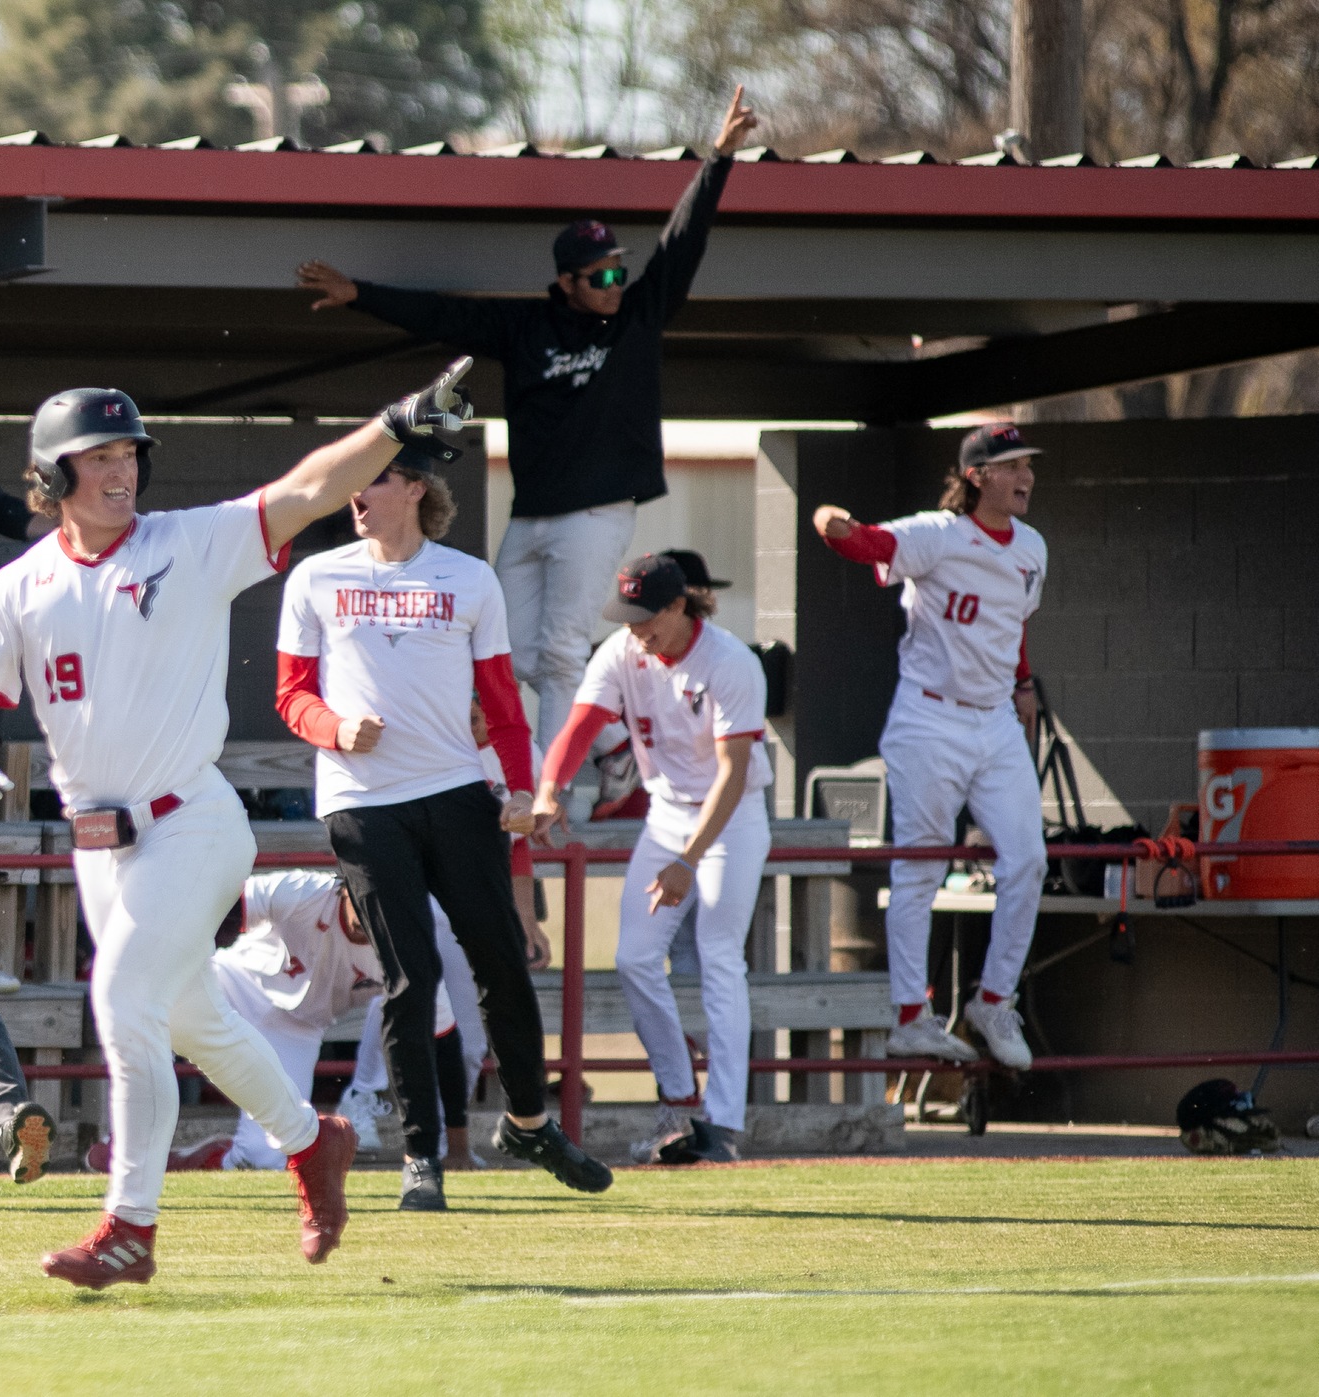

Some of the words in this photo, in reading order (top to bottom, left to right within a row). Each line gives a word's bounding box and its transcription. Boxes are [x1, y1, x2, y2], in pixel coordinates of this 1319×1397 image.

[335, 588, 456, 622] NORTHERN
[943, 590, 980, 626] 10
[339, 616, 451, 632] BASEBALL
[44, 651, 86, 704] 19
